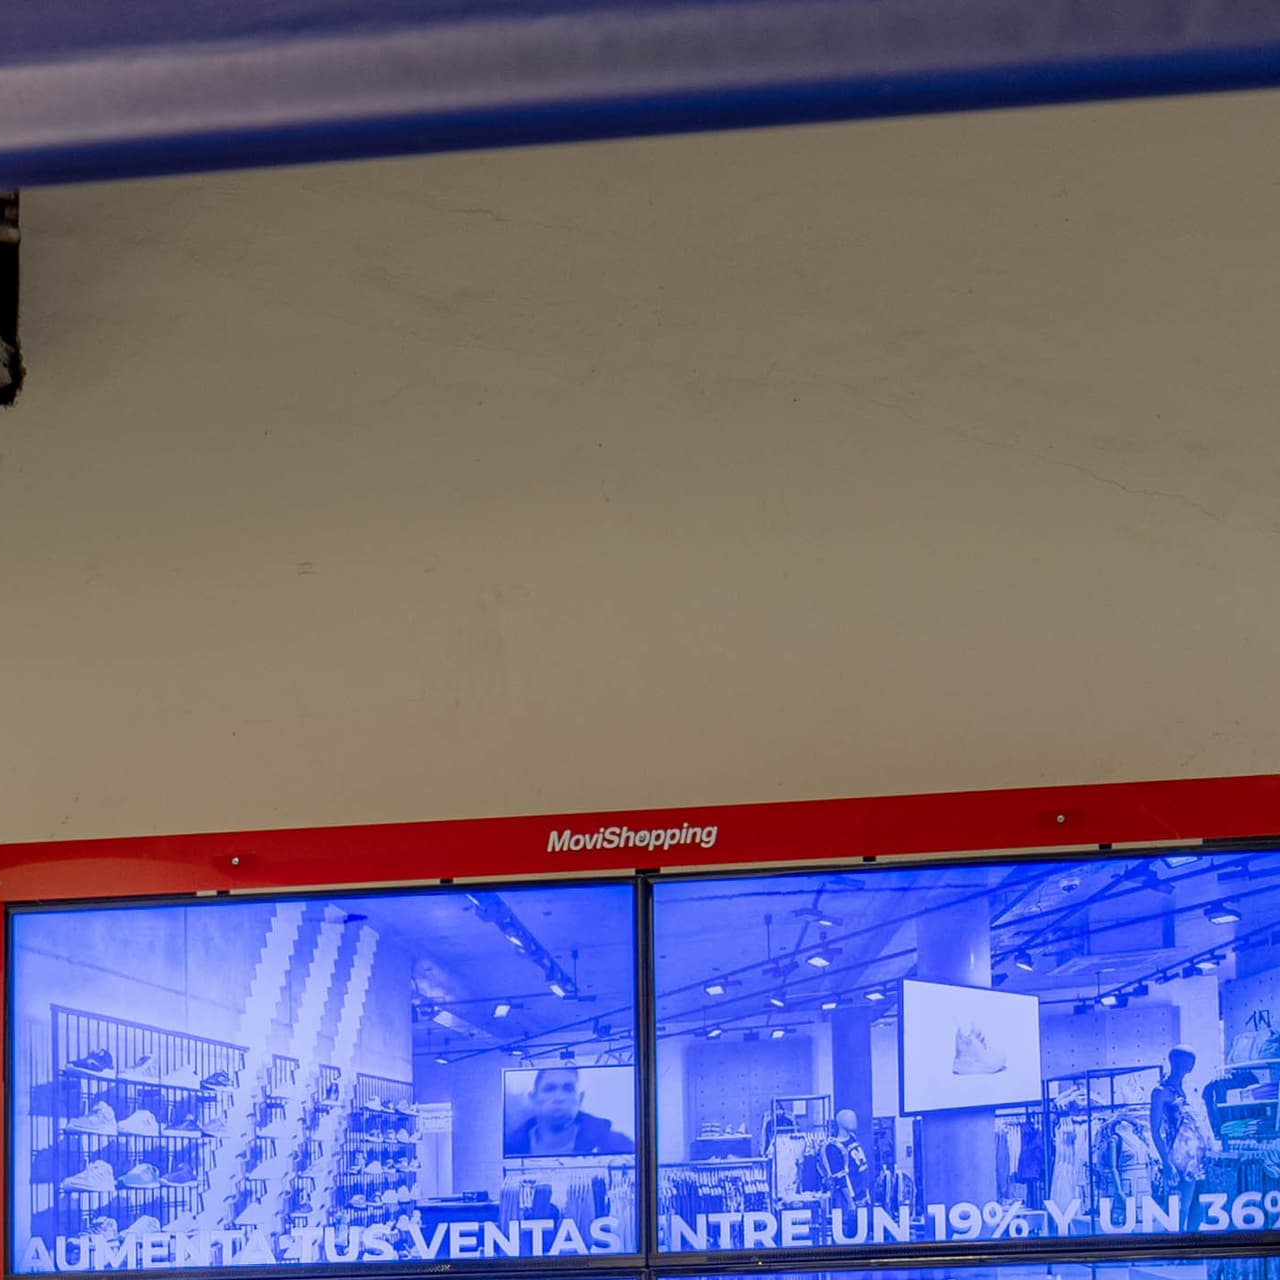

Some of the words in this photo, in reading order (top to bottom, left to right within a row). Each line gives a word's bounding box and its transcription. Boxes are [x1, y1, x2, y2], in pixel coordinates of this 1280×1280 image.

[547, 823, 718, 852] MoviShopping
[20, 1227, 277, 1272] AUMENTA
[291, 1223, 400, 1262] TUS
[409, 1216, 619, 1258] VENTAS
[658, 1208, 813, 1251] NTRE
[832, 1203, 911, 1245] UN
[928, 1199, 1029, 1241] 19%
[1043, 1200, 1083, 1235] Y
[1100, 1195, 1180, 1233] UN
